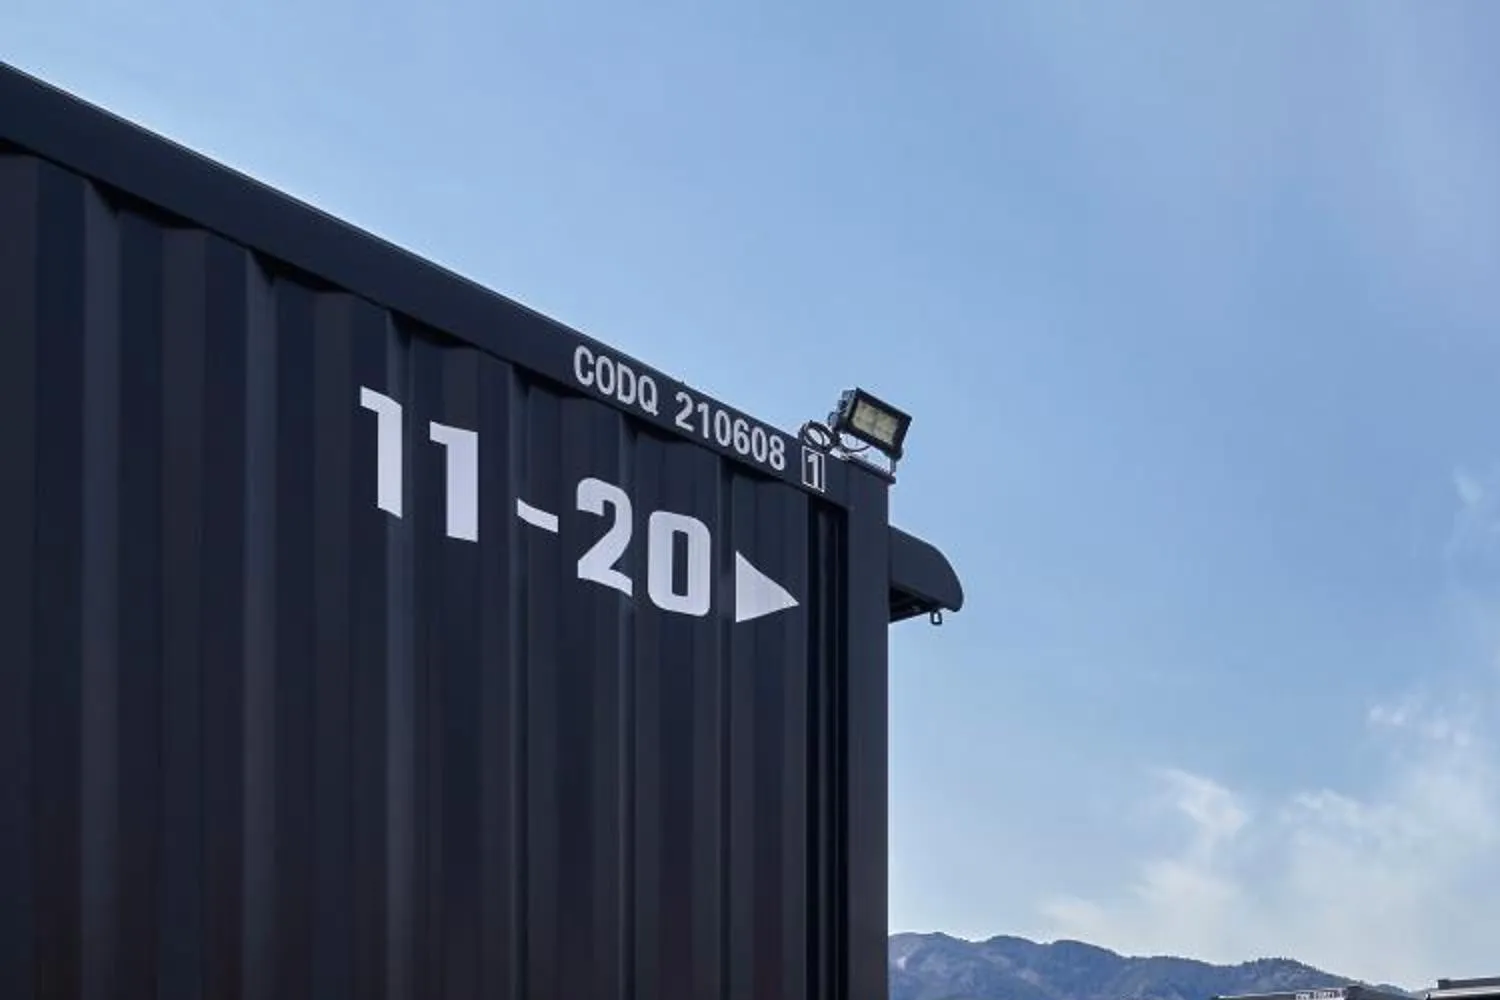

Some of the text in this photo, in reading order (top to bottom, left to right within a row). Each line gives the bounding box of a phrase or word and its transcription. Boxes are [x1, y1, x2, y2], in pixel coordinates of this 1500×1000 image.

[573, 345, 659, 417] CODQ
[675, 391, 786, 471] 210608
[360, 386, 711, 617] 11-20
